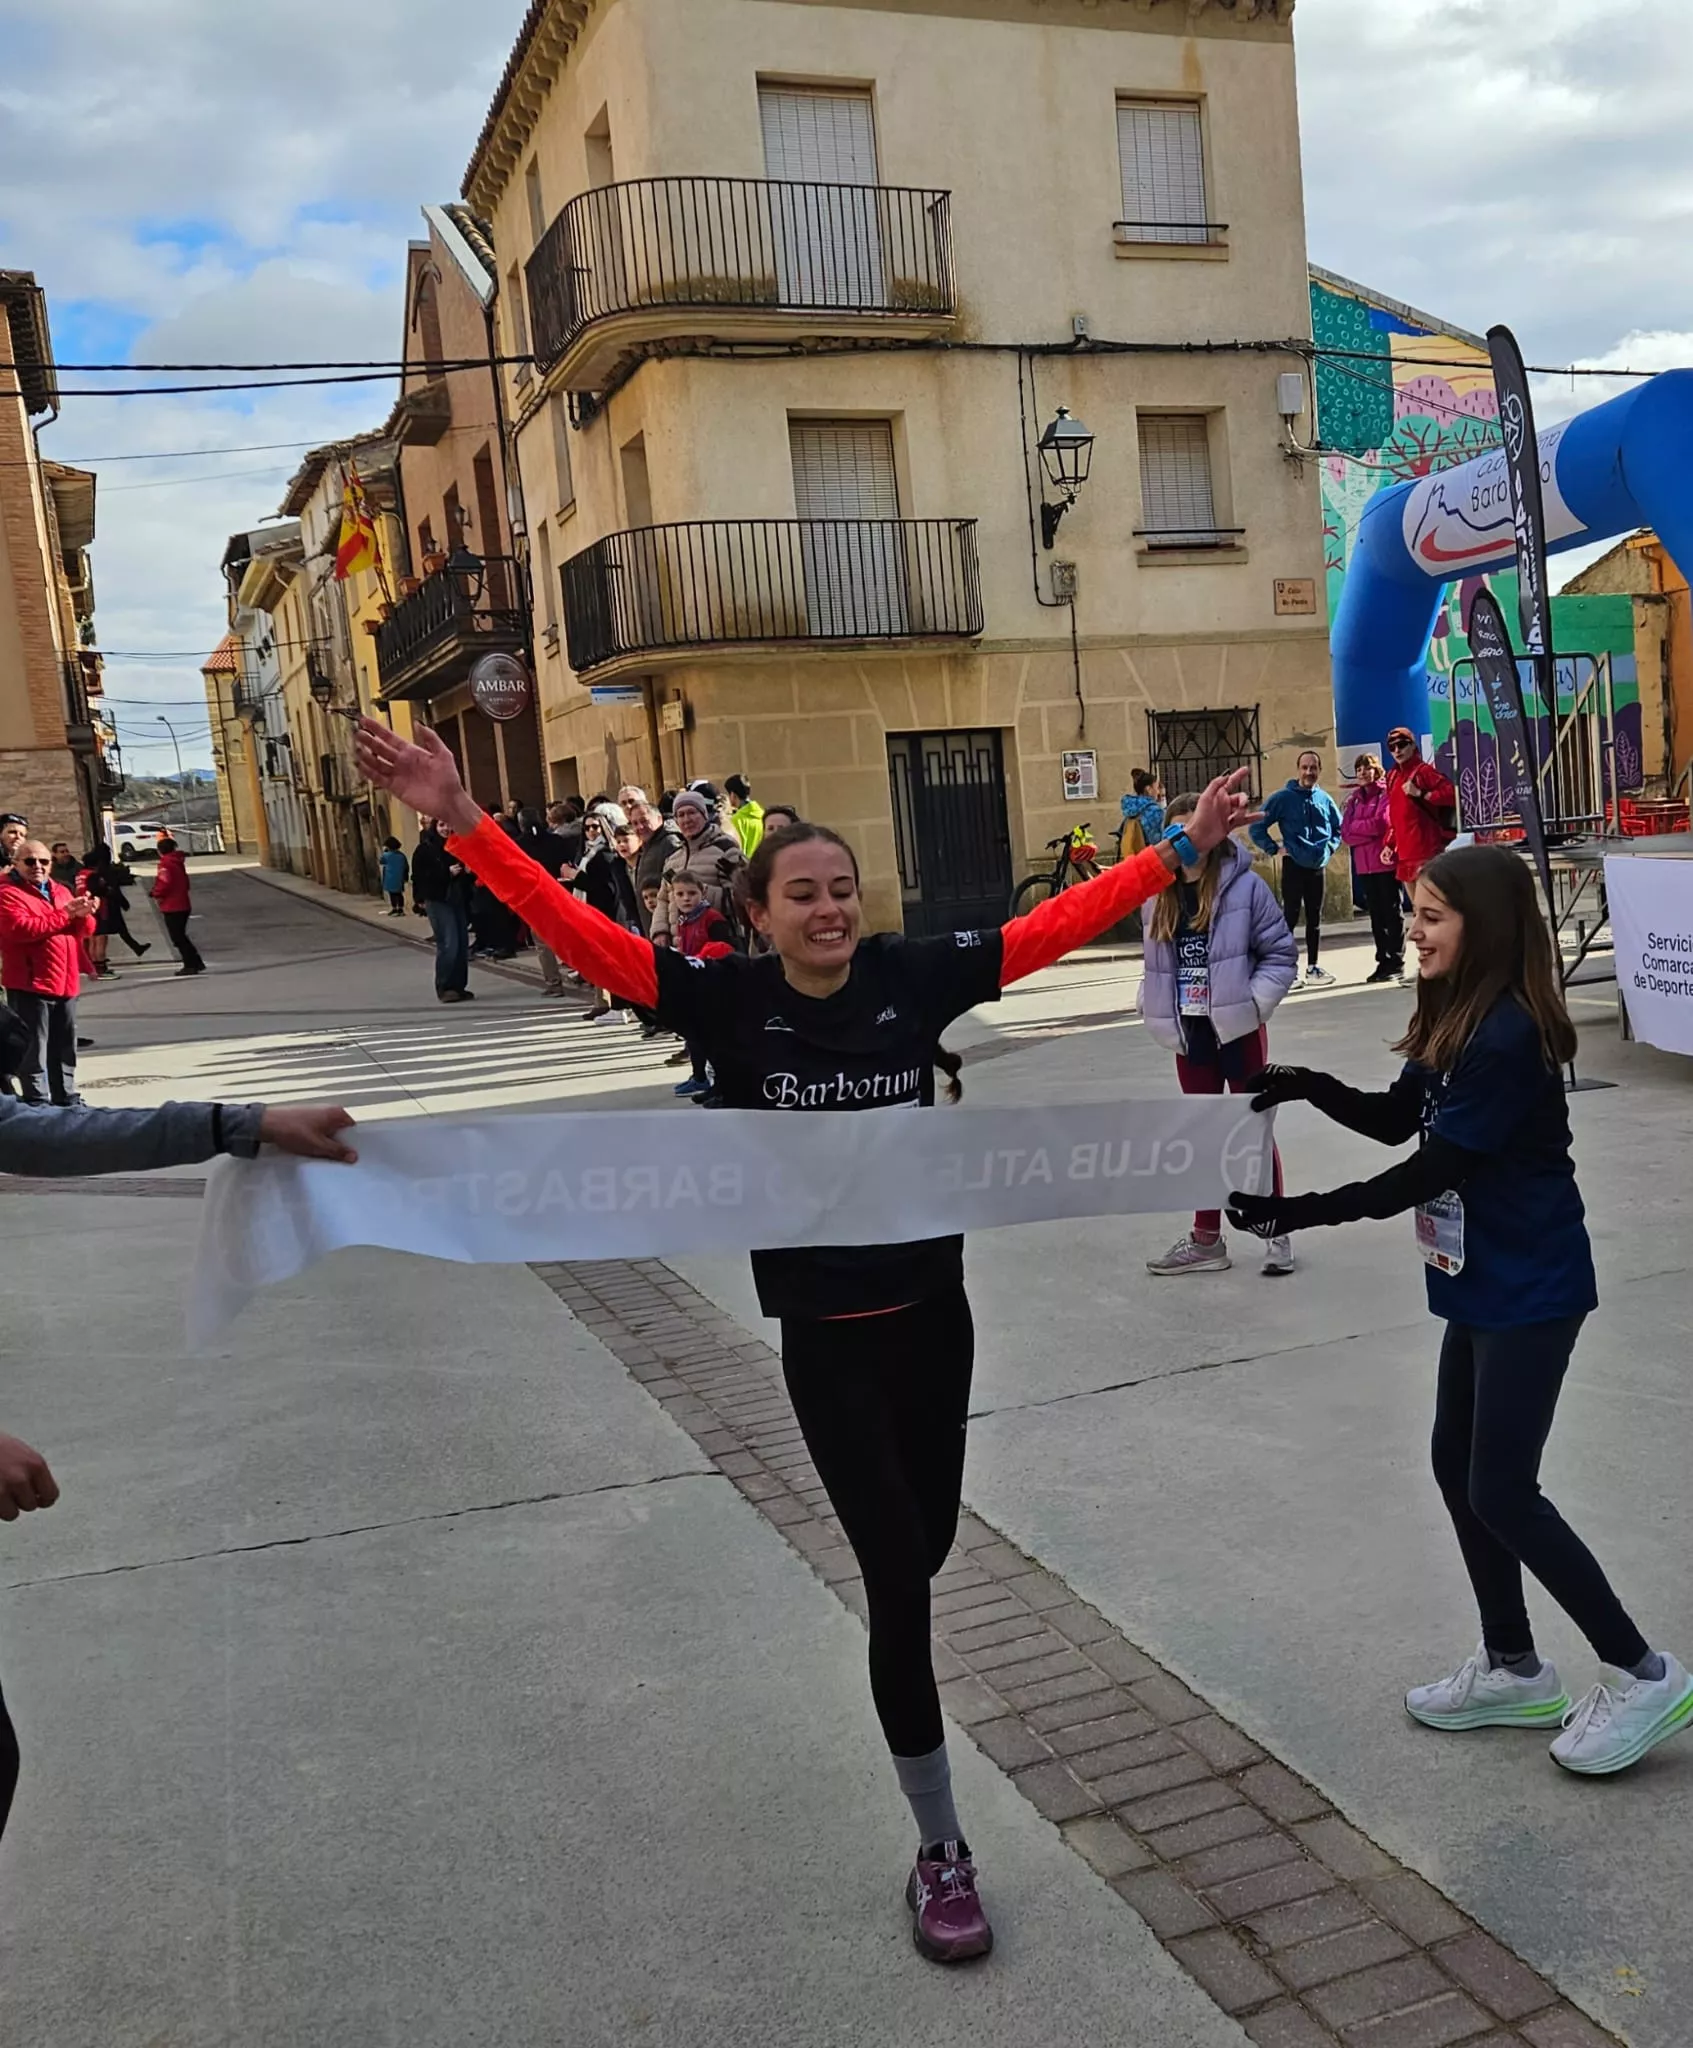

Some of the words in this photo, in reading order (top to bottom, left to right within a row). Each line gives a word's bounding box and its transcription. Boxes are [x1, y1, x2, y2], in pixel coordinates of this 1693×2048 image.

[476, 679, 527, 692] AMBAR
[1634, 970, 1647, 989] de
[1184, 986, 1208, 999] 124
[762, 1066, 920, 1108] Barbotum
